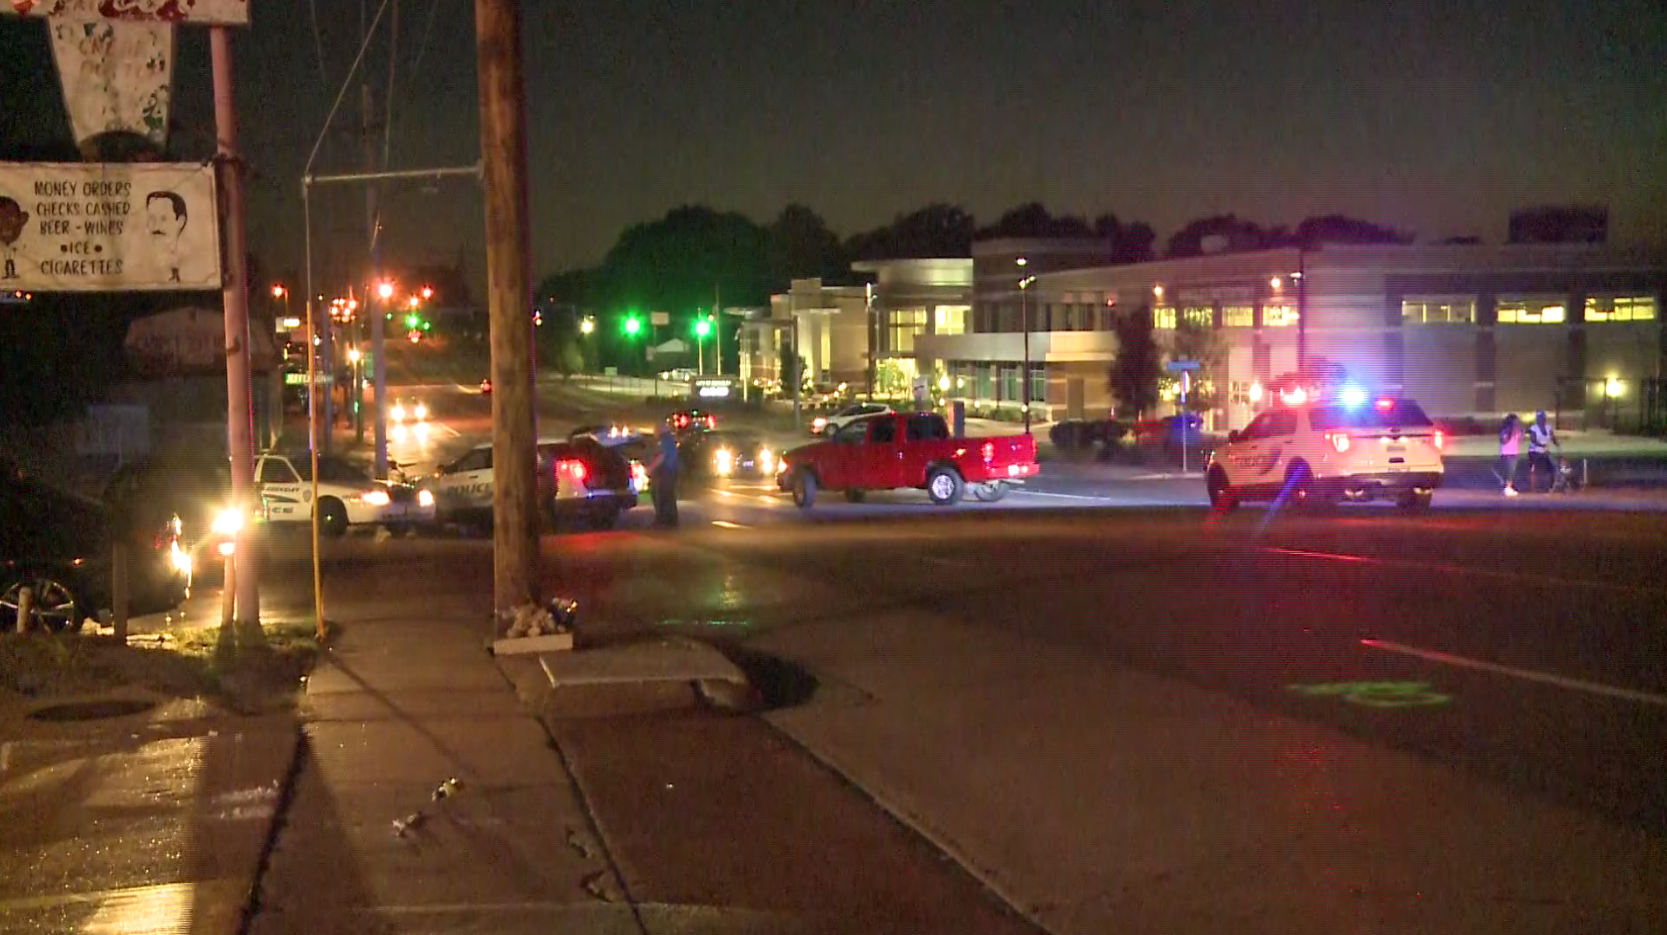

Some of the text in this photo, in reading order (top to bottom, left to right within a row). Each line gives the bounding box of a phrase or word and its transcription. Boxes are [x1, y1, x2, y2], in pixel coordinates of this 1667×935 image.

[34, 181, 131, 197] MONEY ORDERS
[36, 202, 131, 216] CHECKS CASHED
[40, 220, 70, 235] BEER
[84, 220, 123, 235] WINES
[40, 260, 123, 275] CIGARETTES
